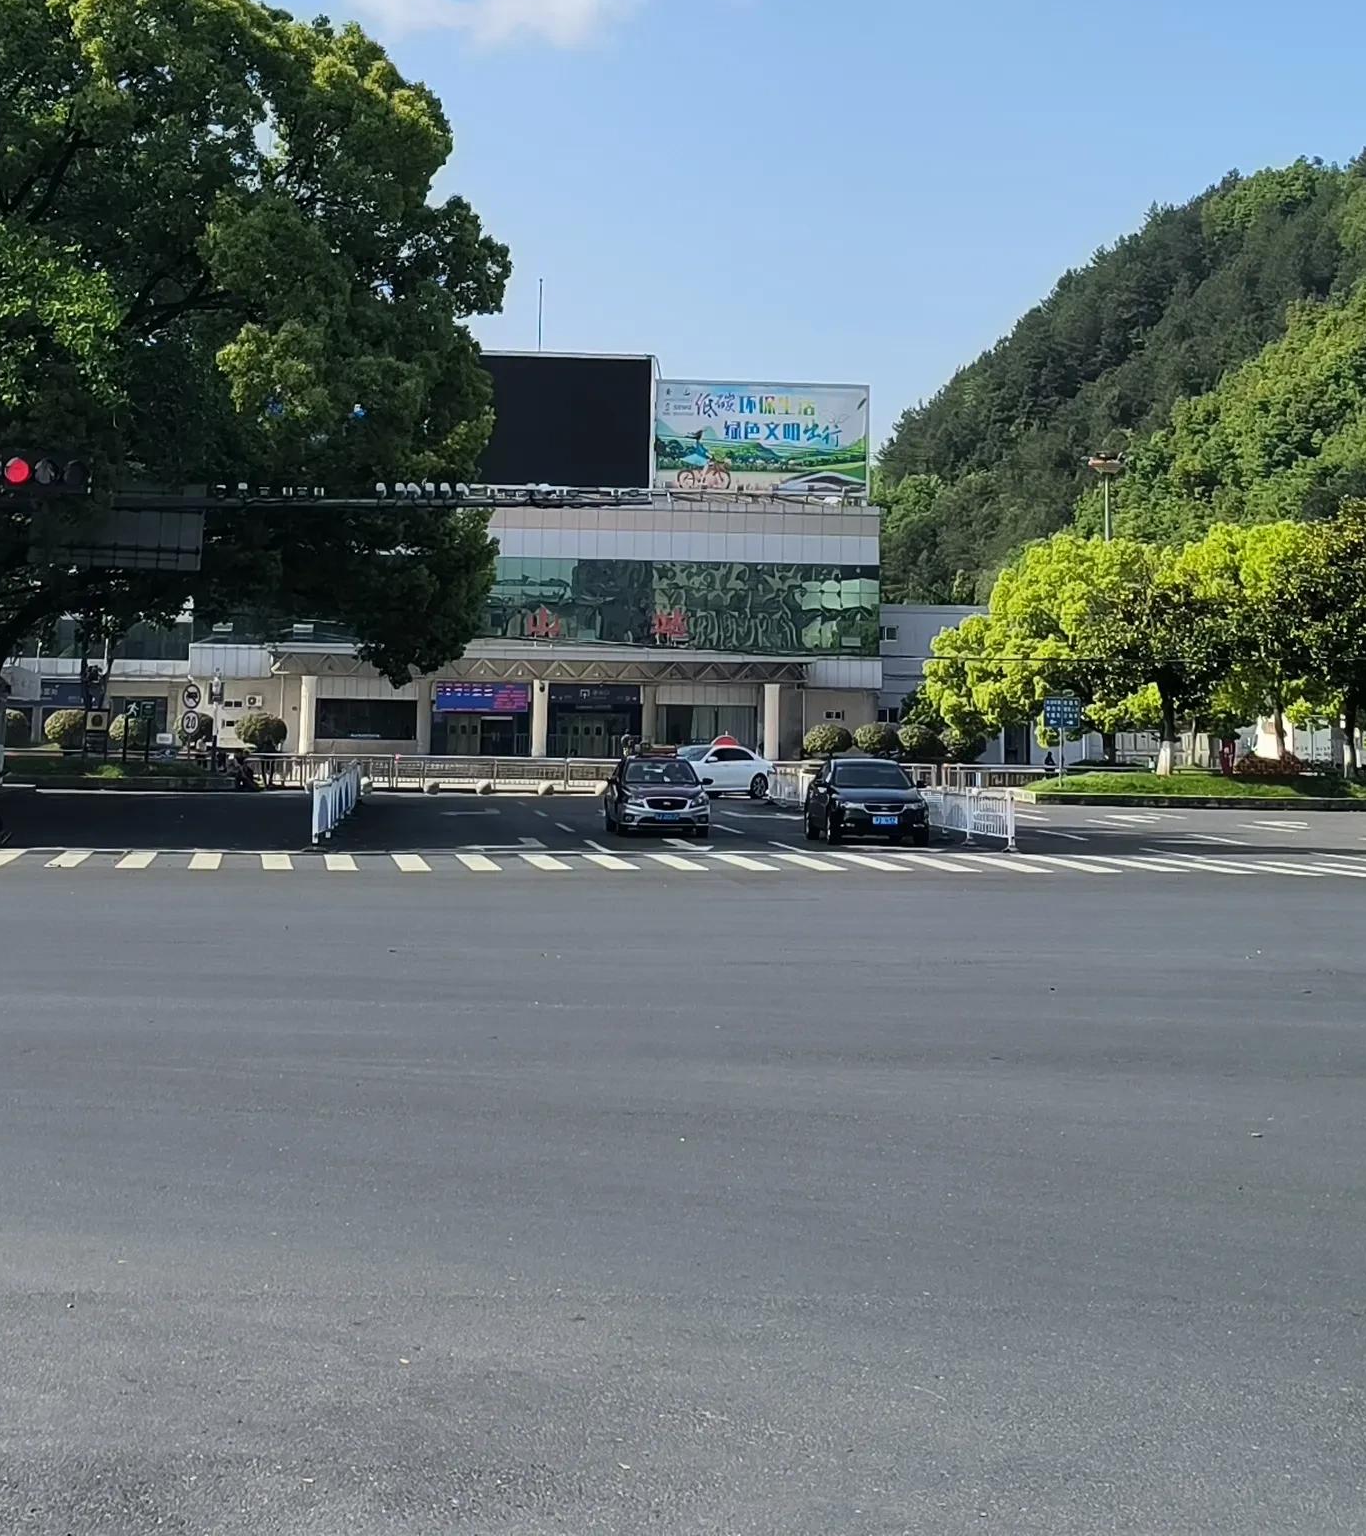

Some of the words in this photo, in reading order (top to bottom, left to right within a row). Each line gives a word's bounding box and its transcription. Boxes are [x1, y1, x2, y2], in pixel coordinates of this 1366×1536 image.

[695, 391, 815, 418] 低碳环保生活
[724, 420, 842, 448] 绿色文明出行
[184, 716, 197, 730] 20
